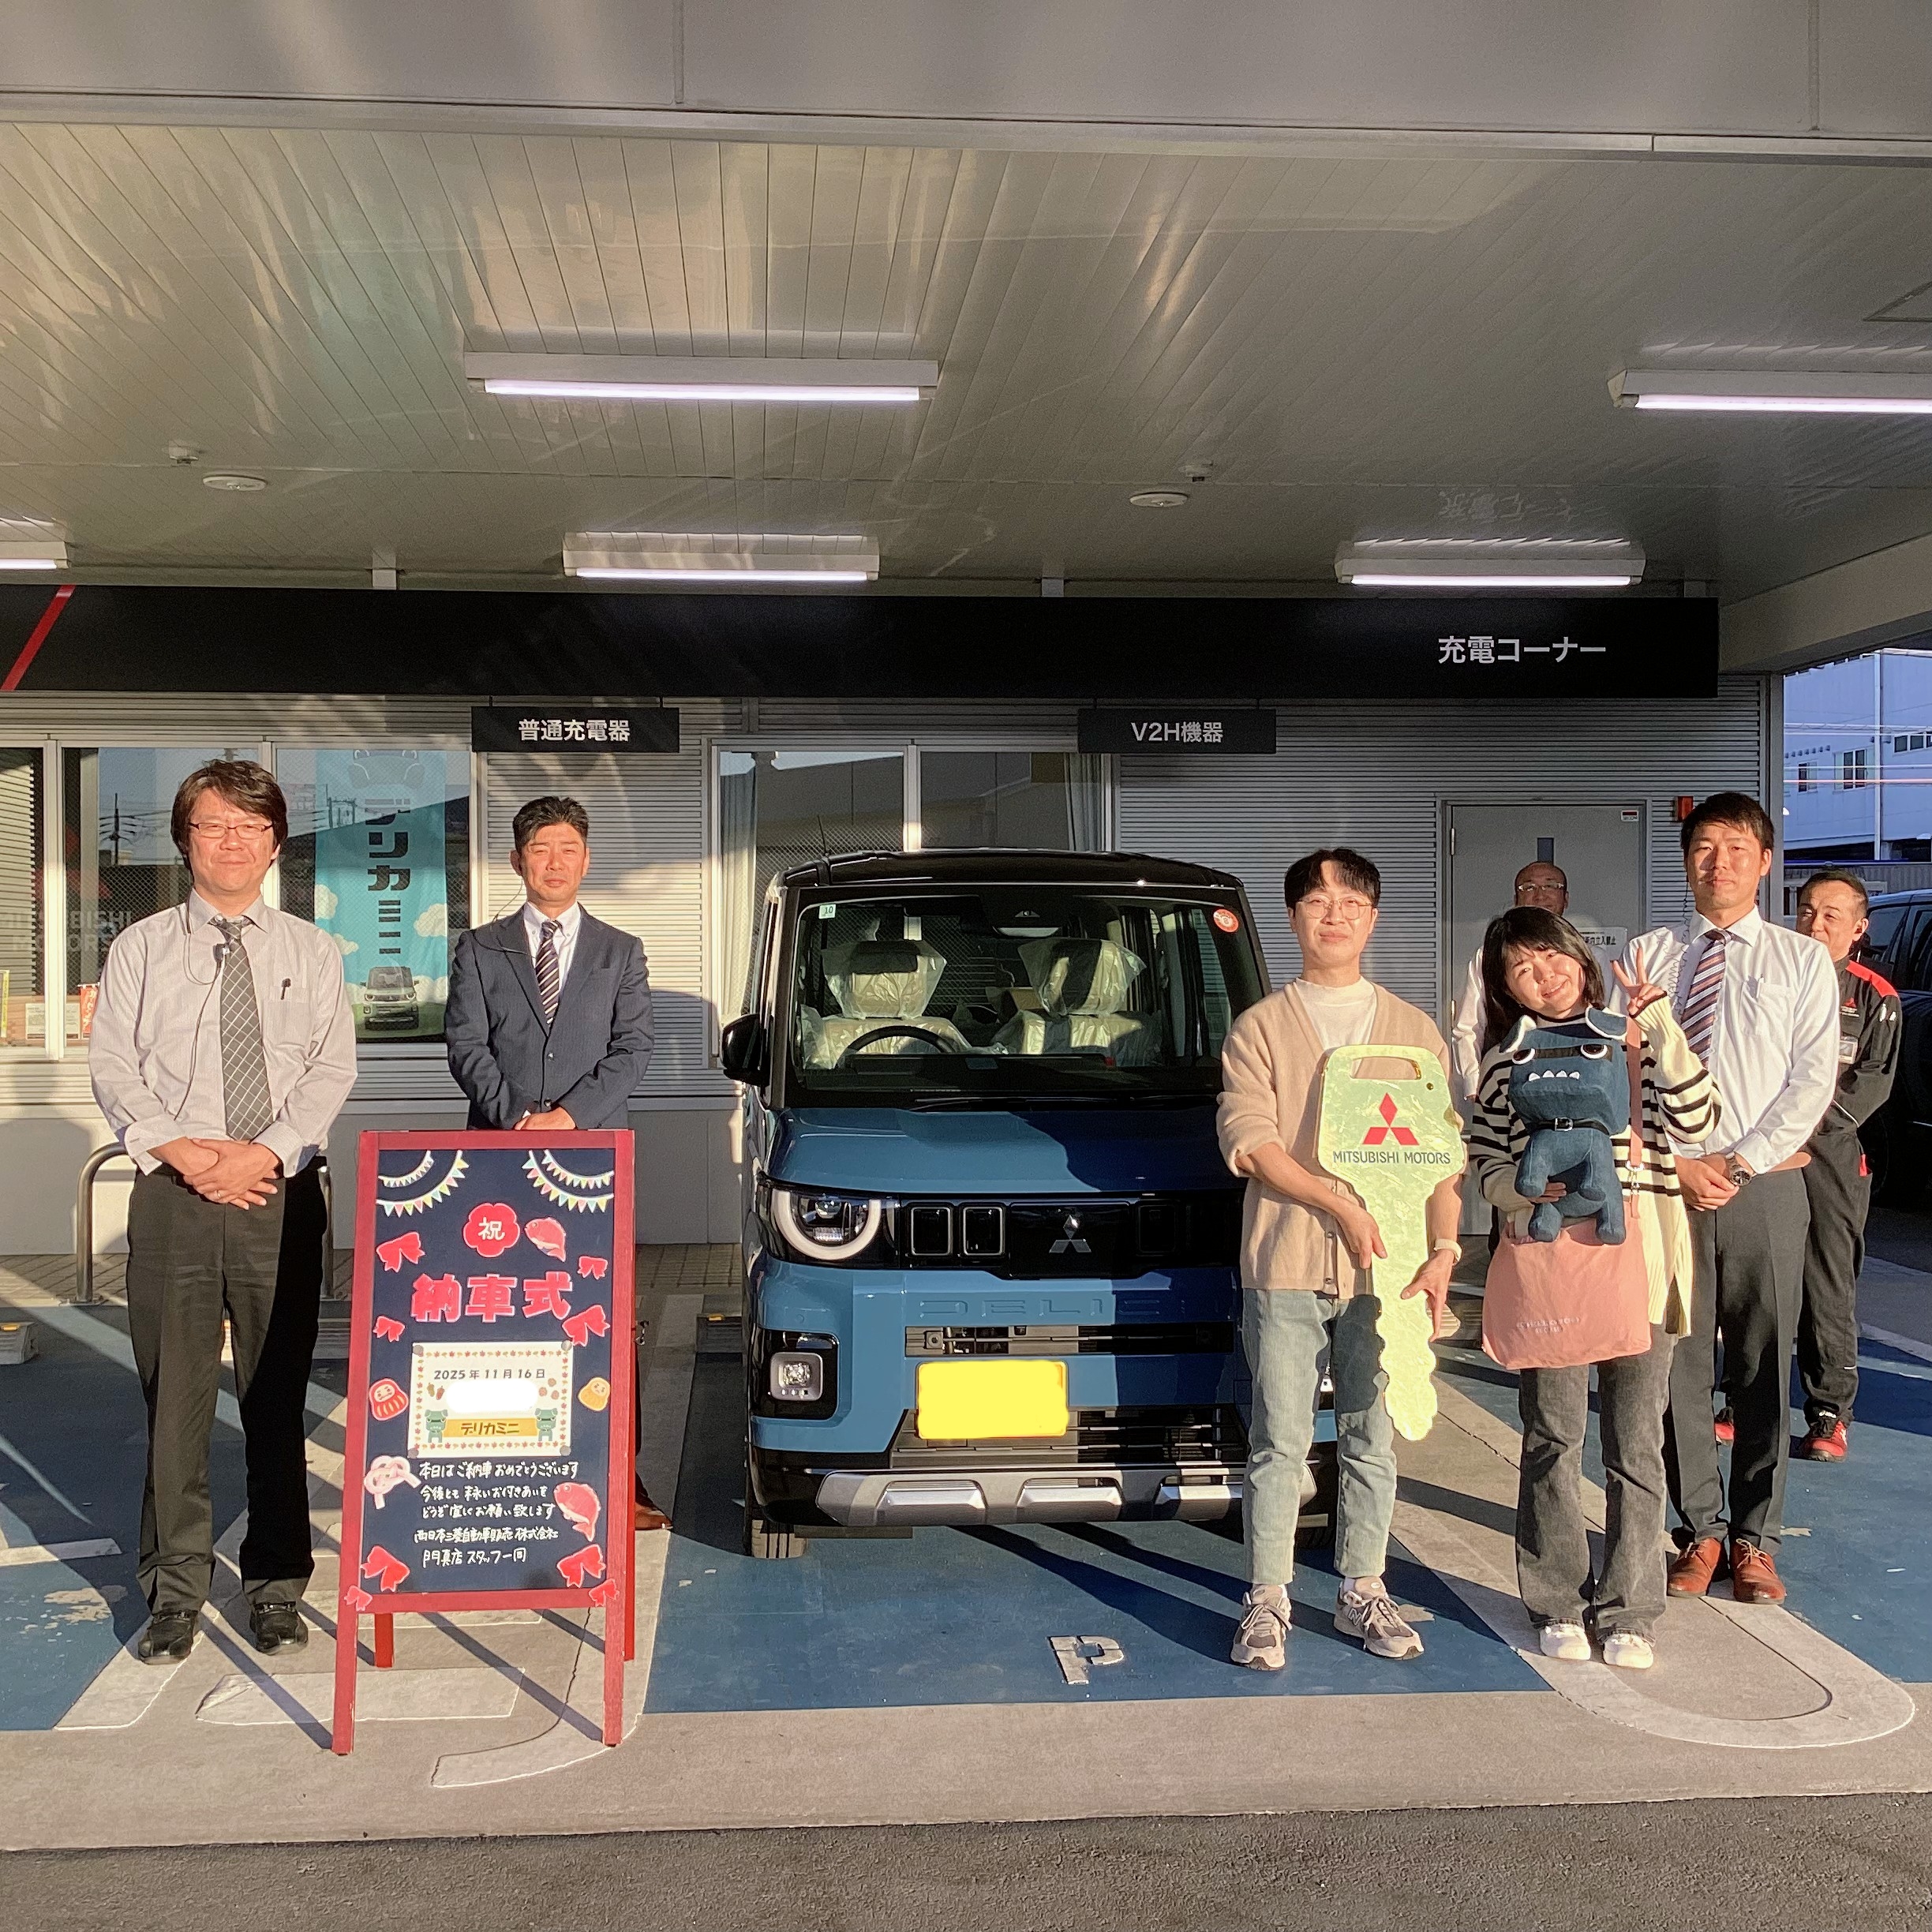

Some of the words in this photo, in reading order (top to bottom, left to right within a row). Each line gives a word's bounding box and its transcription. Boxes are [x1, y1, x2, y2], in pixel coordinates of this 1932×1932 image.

[1438, 635, 1606, 665] 充電コーナー
[519, 718, 631, 742] 普通充電器
[1130, 721, 1223, 743] V2H機器
[1333, 1151, 1399, 1163] MITSUBISHI
[1404, 1151, 1451, 1164] MOTORS
[477, 1217, 505, 1240] 祝
[410, 1271, 573, 1323] 納車式
[460, 1421, 520, 1435] デリカミニ
[1047, 1634, 1125, 1685] P
